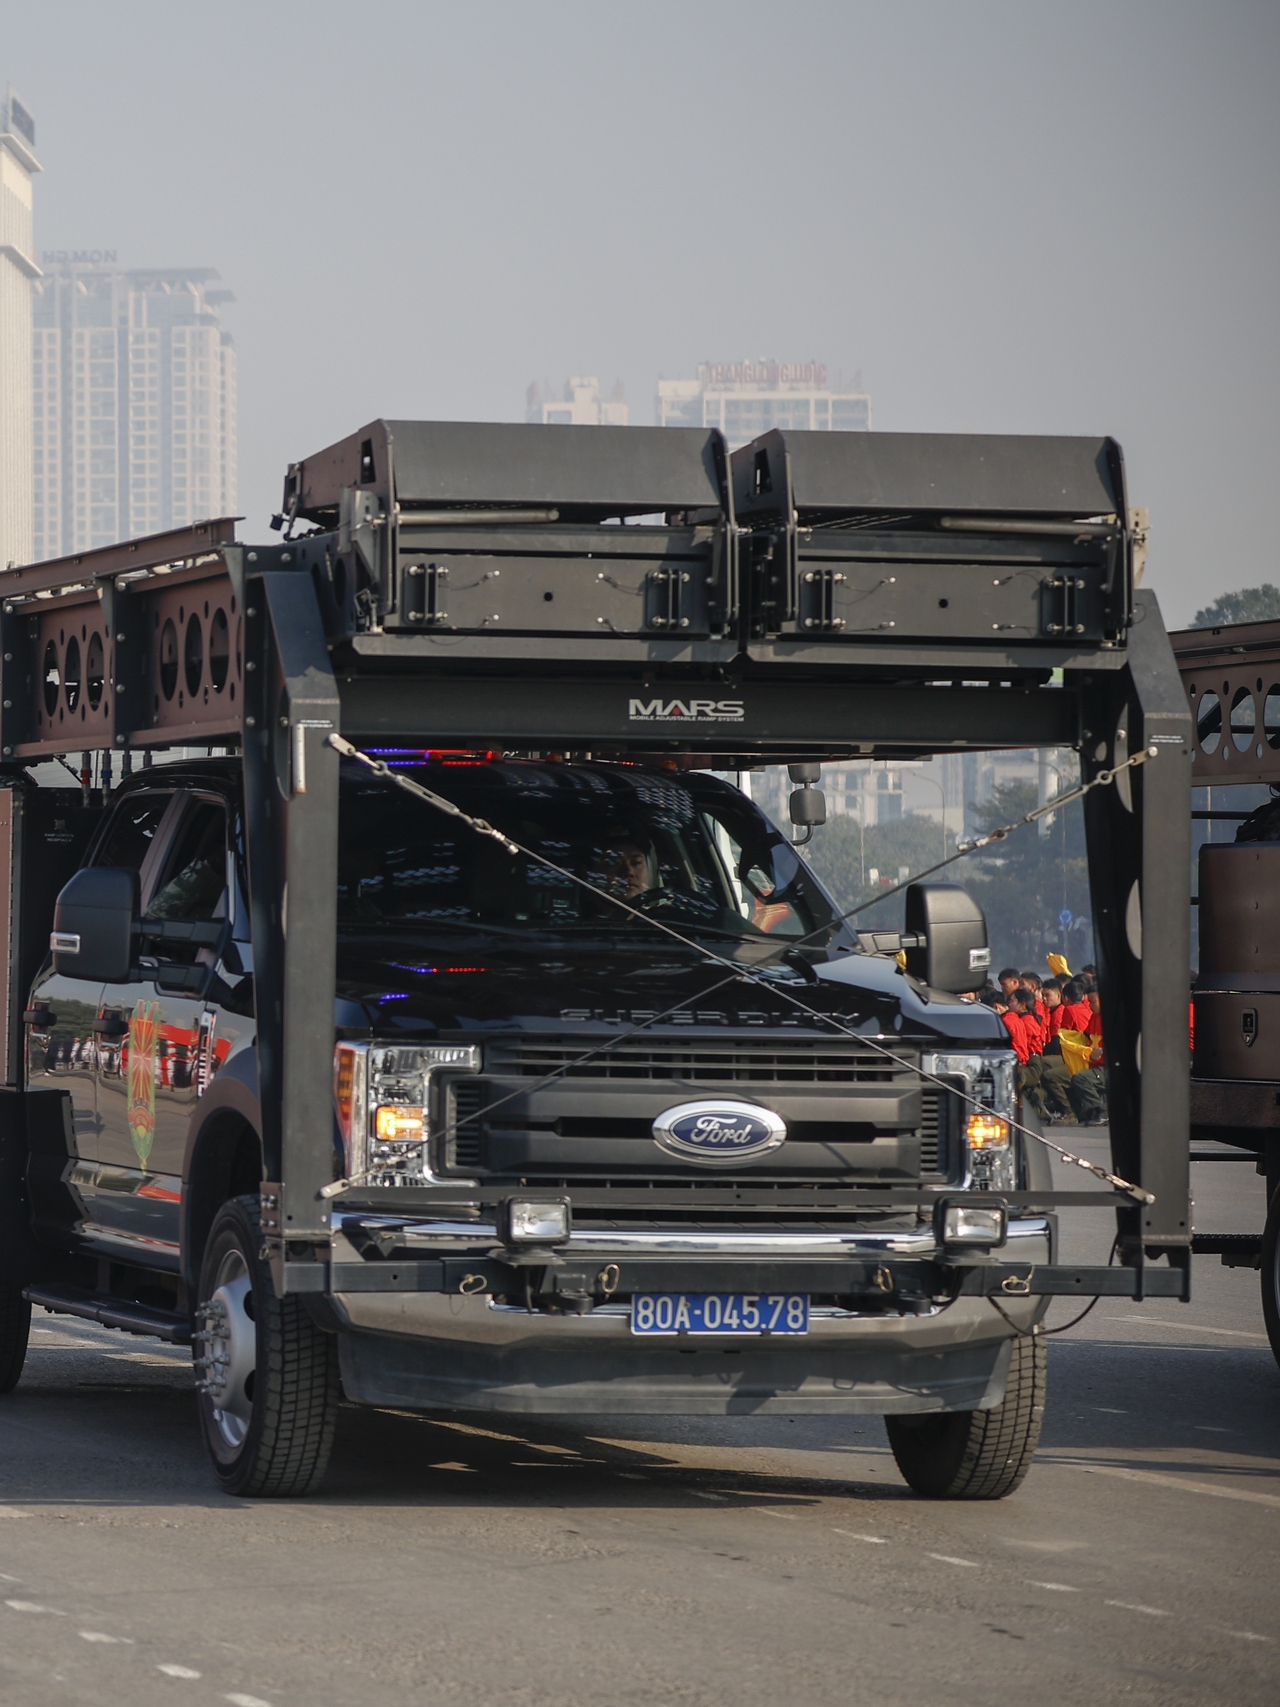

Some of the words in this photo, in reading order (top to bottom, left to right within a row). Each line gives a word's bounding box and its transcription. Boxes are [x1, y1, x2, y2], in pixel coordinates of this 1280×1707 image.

[628, 699, 745, 717] MARS
[560, 1008, 729, 1025] SUPER
[737, 1010, 860, 1028] DUTY
[690, 1115, 753, 1144] Ford
[636, 1295, 805, 1330] 80A-045.78
